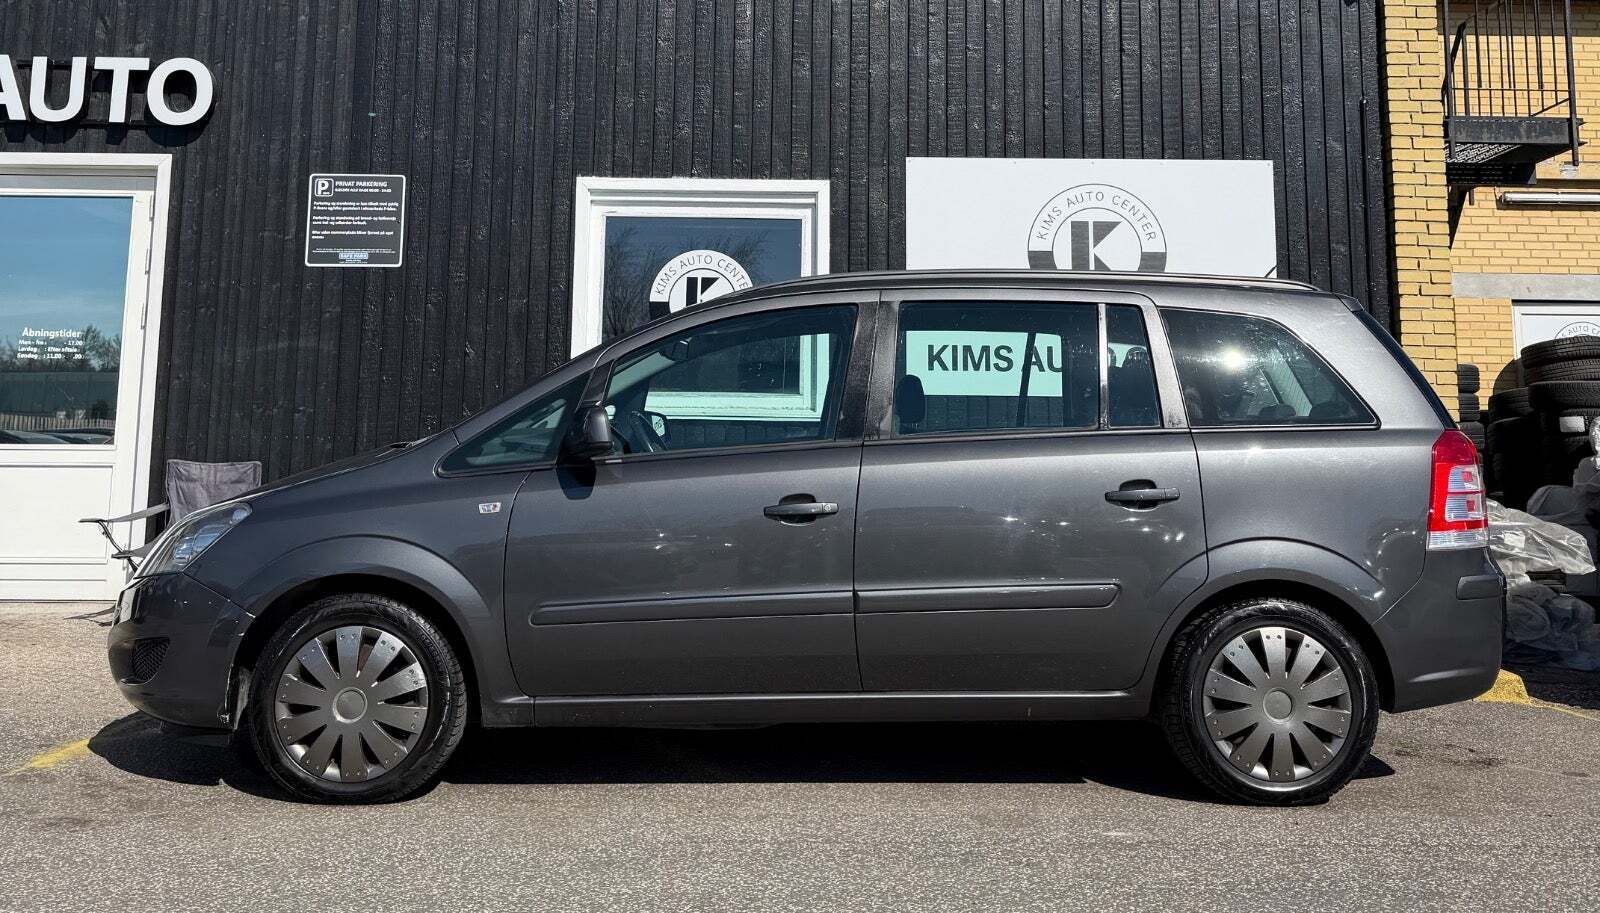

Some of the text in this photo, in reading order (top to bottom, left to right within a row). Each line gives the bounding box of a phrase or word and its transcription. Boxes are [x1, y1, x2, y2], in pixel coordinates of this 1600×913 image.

[1036, 191, 1157, 241] KIMS AUTO CENTER
[1070, 220, 1123, 271] K
[655, 255, 749, 295] KIMS AUTO CENTE
[22, 327, 81, 339] Åbningstider
[927, 344, 1014, 373] KIMS
